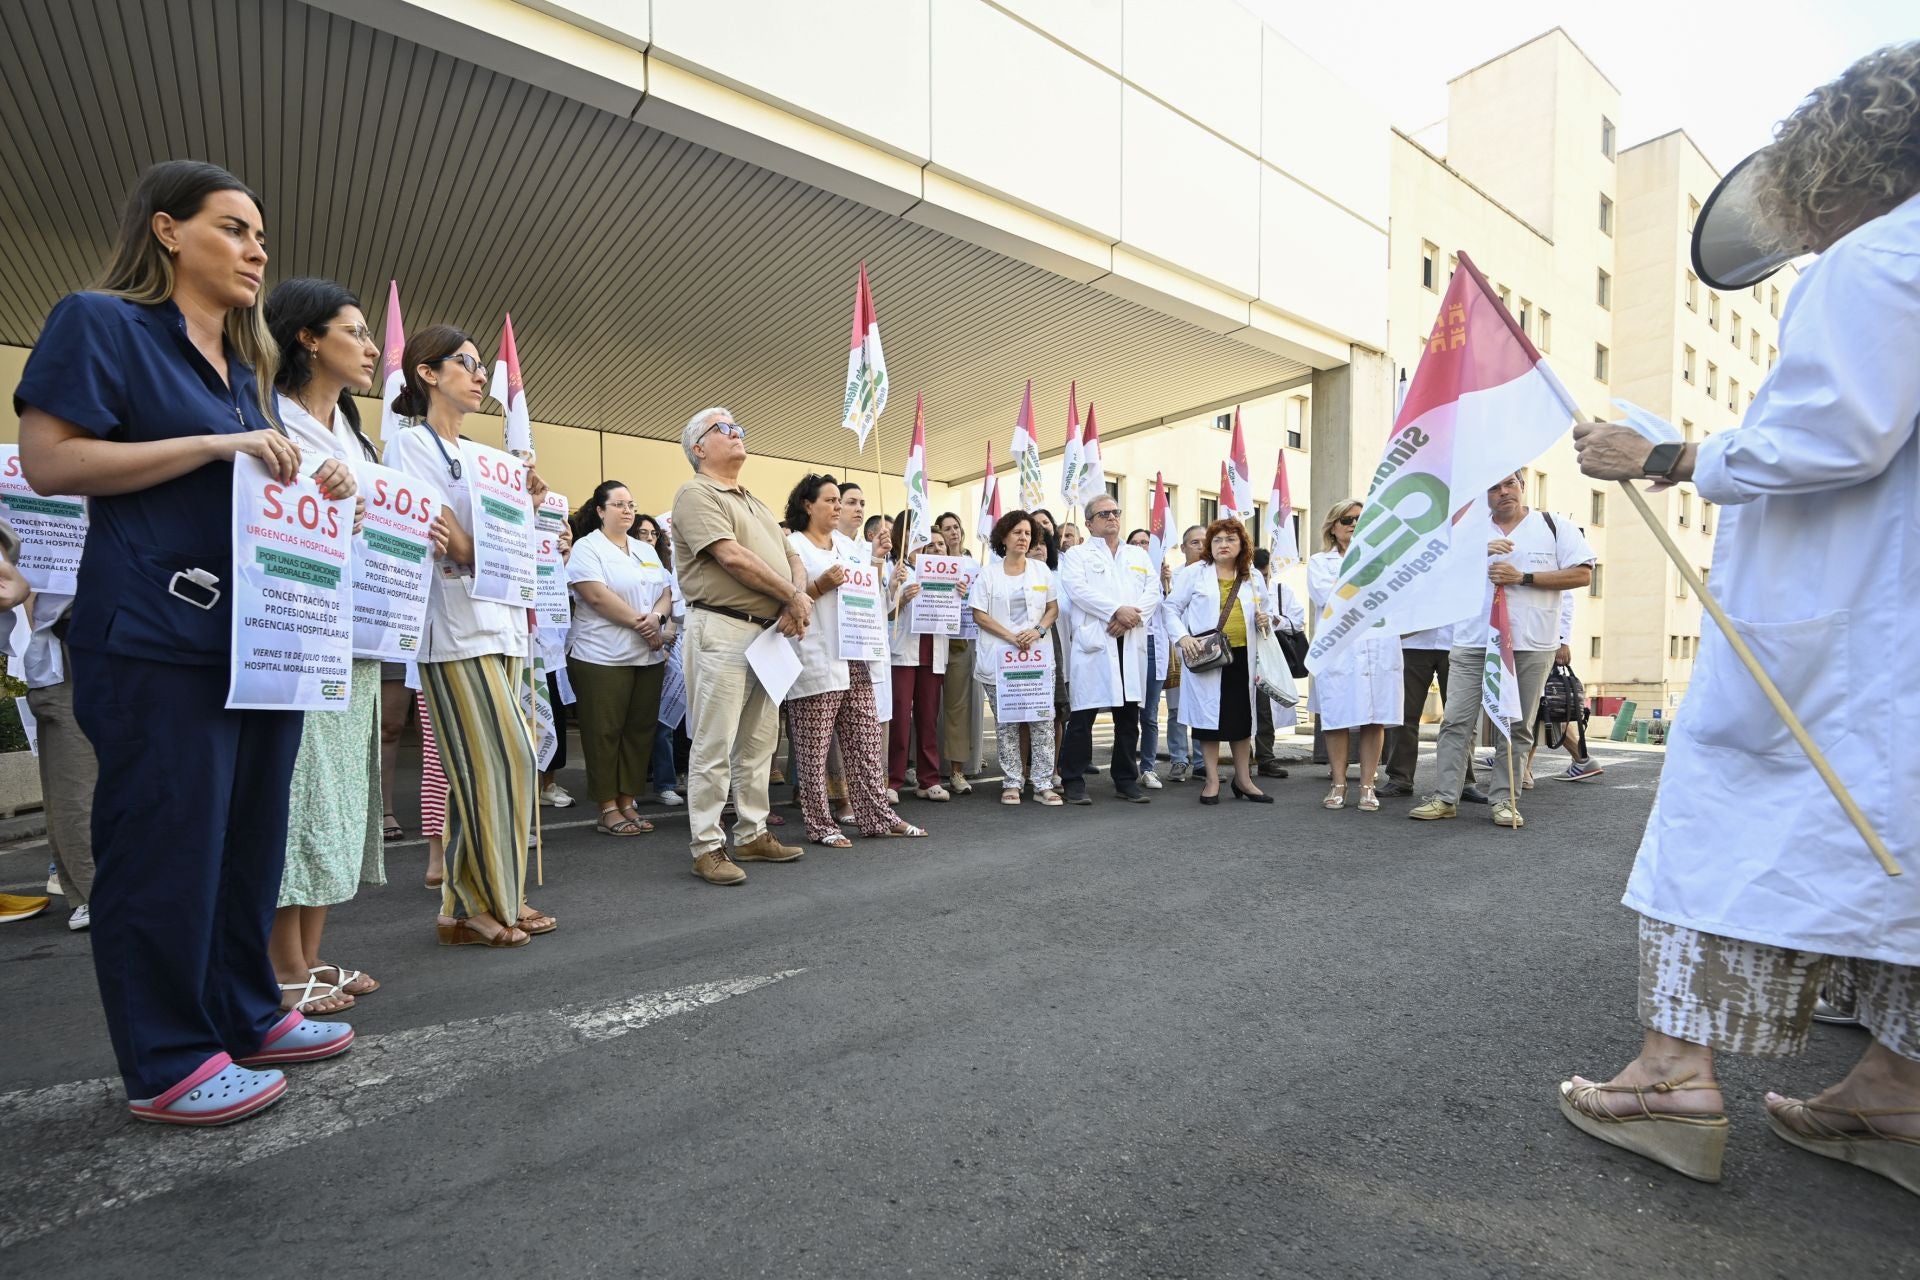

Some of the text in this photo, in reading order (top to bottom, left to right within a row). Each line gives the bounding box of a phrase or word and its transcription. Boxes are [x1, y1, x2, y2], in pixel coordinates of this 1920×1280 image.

[478, 455, 521, 492] S.O.S
[373, 478, 430, 523] S.O.S
[263, 484, 338, 539] S.O.S
[363, 512, 392, 527] RGENCIAS
[247, 525, 345, 560] URGENCIAS HOSPITALARIAS
[33, 563, 68, 571] MORALES
[260, 552, 340, 577] POR UNAS CONDICIONES
[365, 559, 422, 580] CONCENTRACIÓN DE
[924, 561, 958, 574] S.O.S
[267, 564, 334, 585] LABORALES JUSTAS
[366, 572, 411, 589] PROFESIONALES
[843, 568, 872, 587] S.O.S
[262, 588, 340, 610] CONCENTRACIÓN DE
[387, 589, 426, 603] HOSPITALARIAS
[265, 604, 337, 623] PROFESIONALES DE
[354, 605, 375, 614] VIERNES
[245, 617, 349, 639] URGENCIAS HOSPITALARIAS
[352, 615, 373, 624] OSPITAL
[374, 619, 397, 628] MORALES
[253, 648, 282, 659] VIERNES
[284, 651, 292, 659] 18
[293, 651, 301, 660] DE
[302, 653, 320, 662] JULIO
[321, 655, 336, 663] 10:00
[1005, 649, 1042, 662] S.O.S
[245, 661, 347, 676] HOSPITAL MORALES MESEGUER
